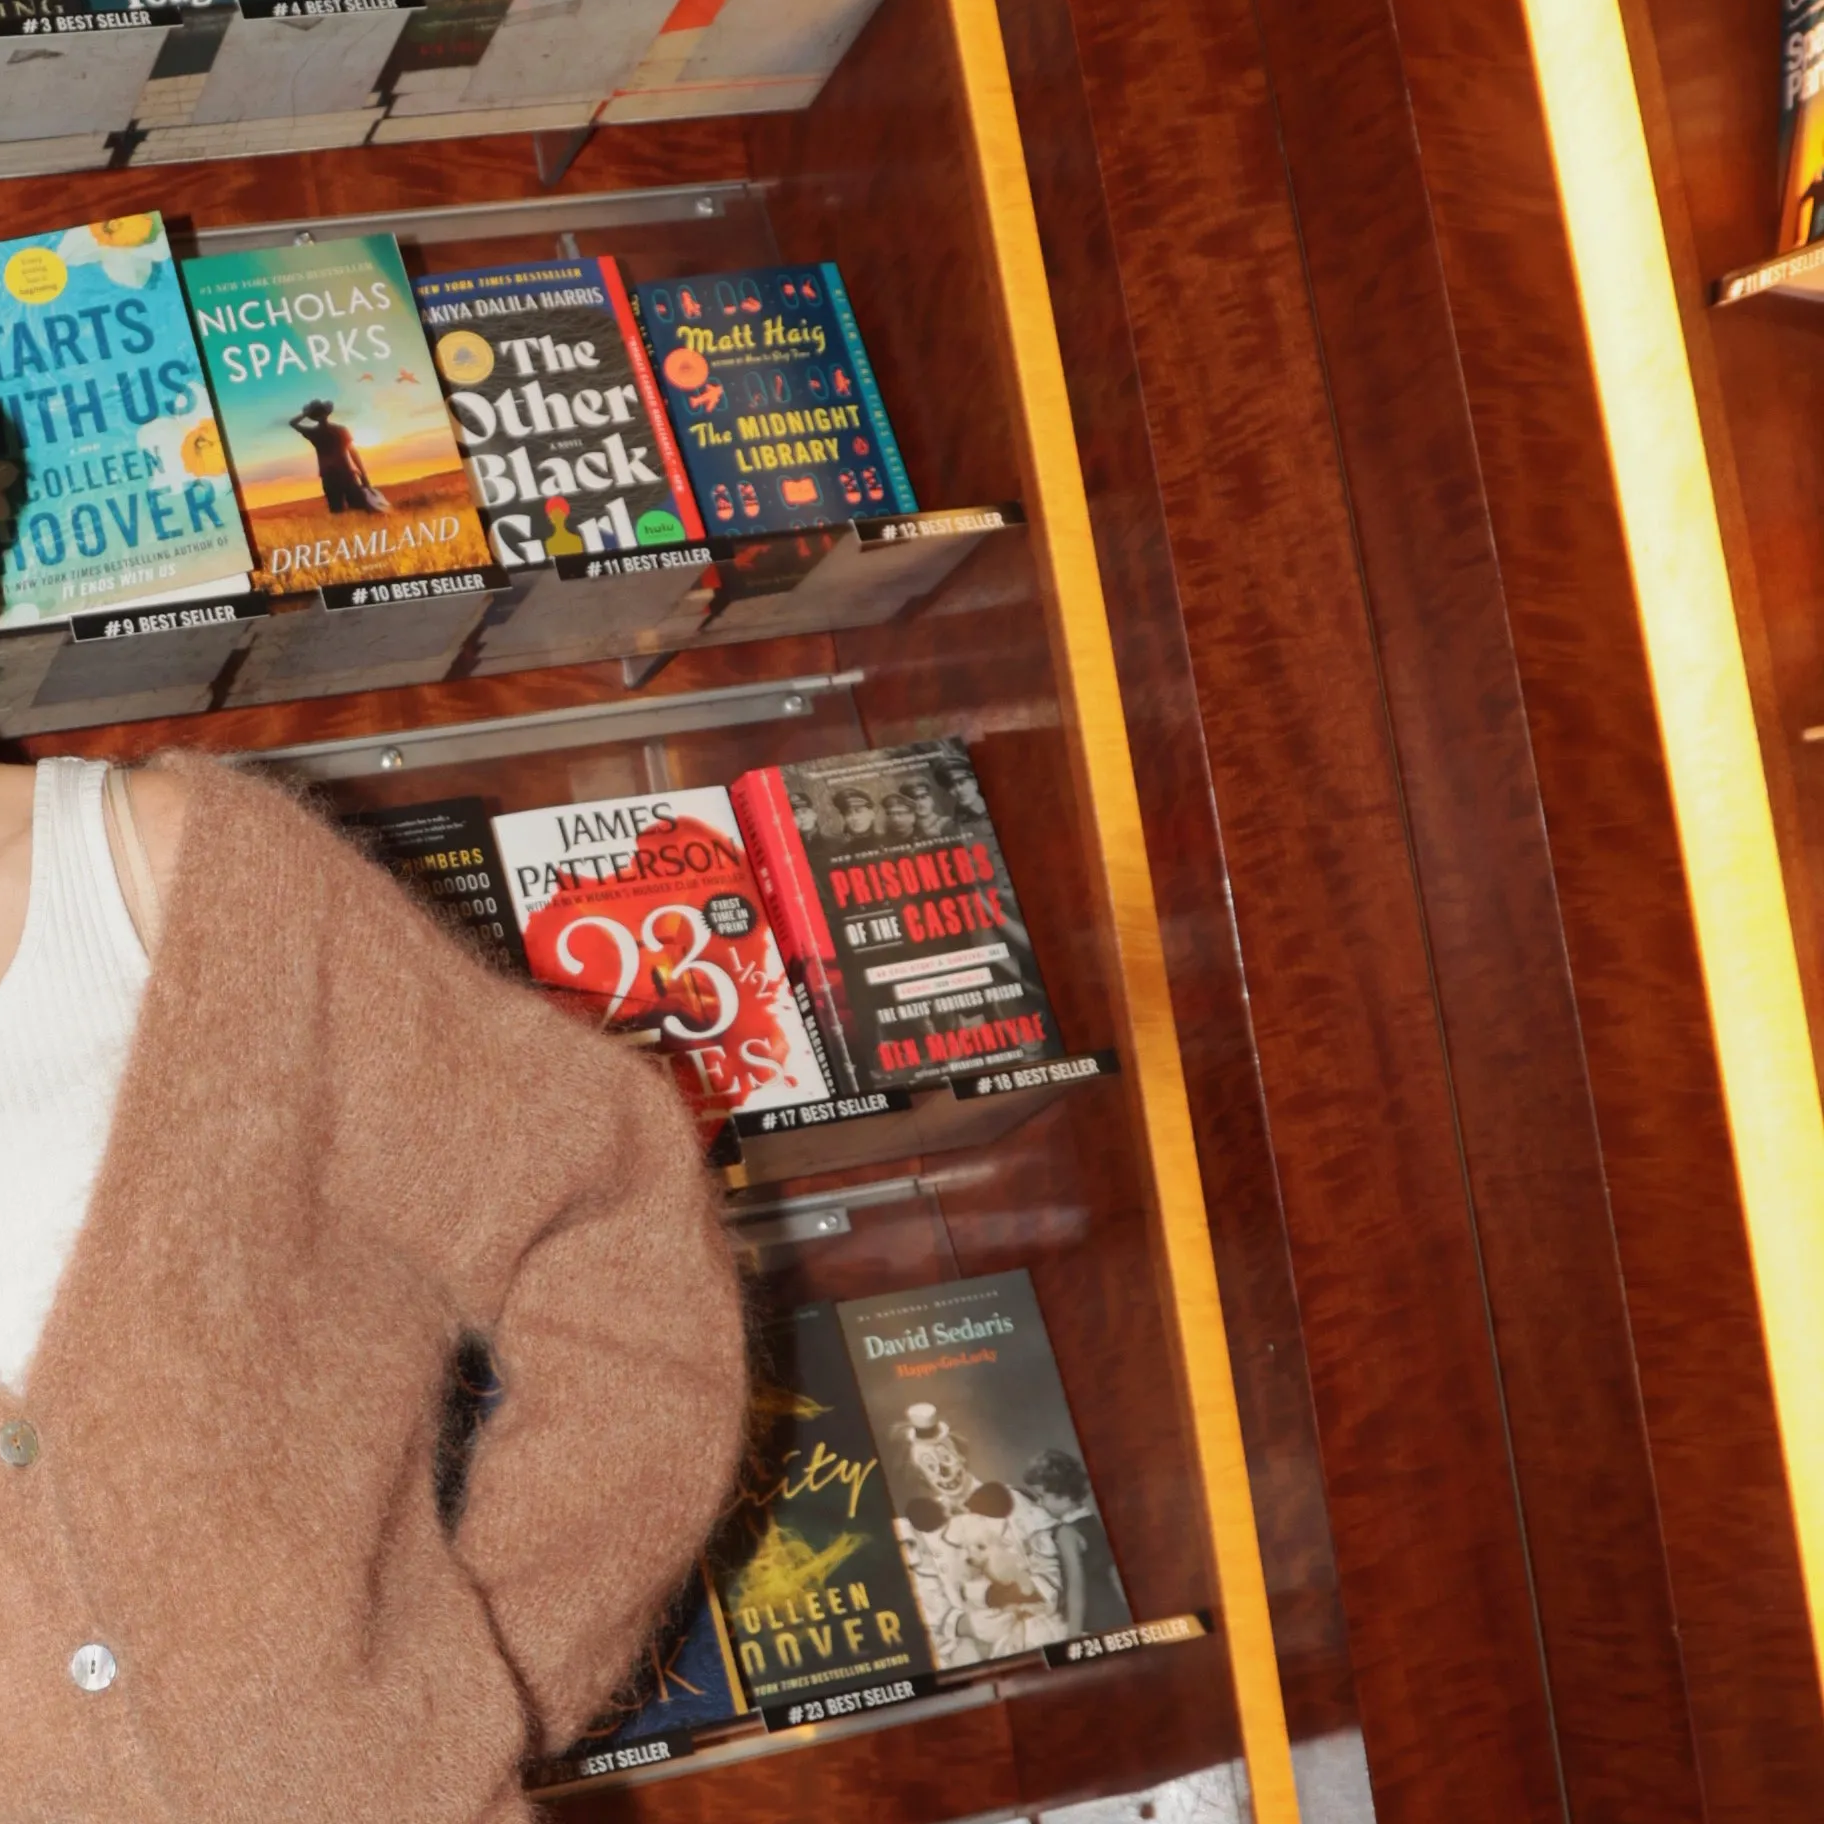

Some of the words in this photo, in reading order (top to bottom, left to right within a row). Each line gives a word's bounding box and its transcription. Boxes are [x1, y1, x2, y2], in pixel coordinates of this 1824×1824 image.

[197, 282, 393, 339] NICHOLAS
[677, 323, 756, 358] Matt
[762, 318, 827, 354] Haig
[220, 324, 394, 384] SPARKS
[689, 421, 732, 447] The
[737, 404, 861, 442] MIDNIGHT
[734, 436, 842, 472] LIBRARY
[270, 513, 461, 576] DREAMLAND
[555, 802, 679, 854] JAMES
[515, 835, 745, 898] PATTERSON
[829, 844, 995, 908] PRISONERS
[903, 888, 1006, 943] CASTLE
[878, 1036, 921, 1072] BEN
[928, 1013, 1047, 1062] MACINTYRE
[865, 1324, 930, 1360] David
[933, 1311, 1014, 1348] Sedaris
